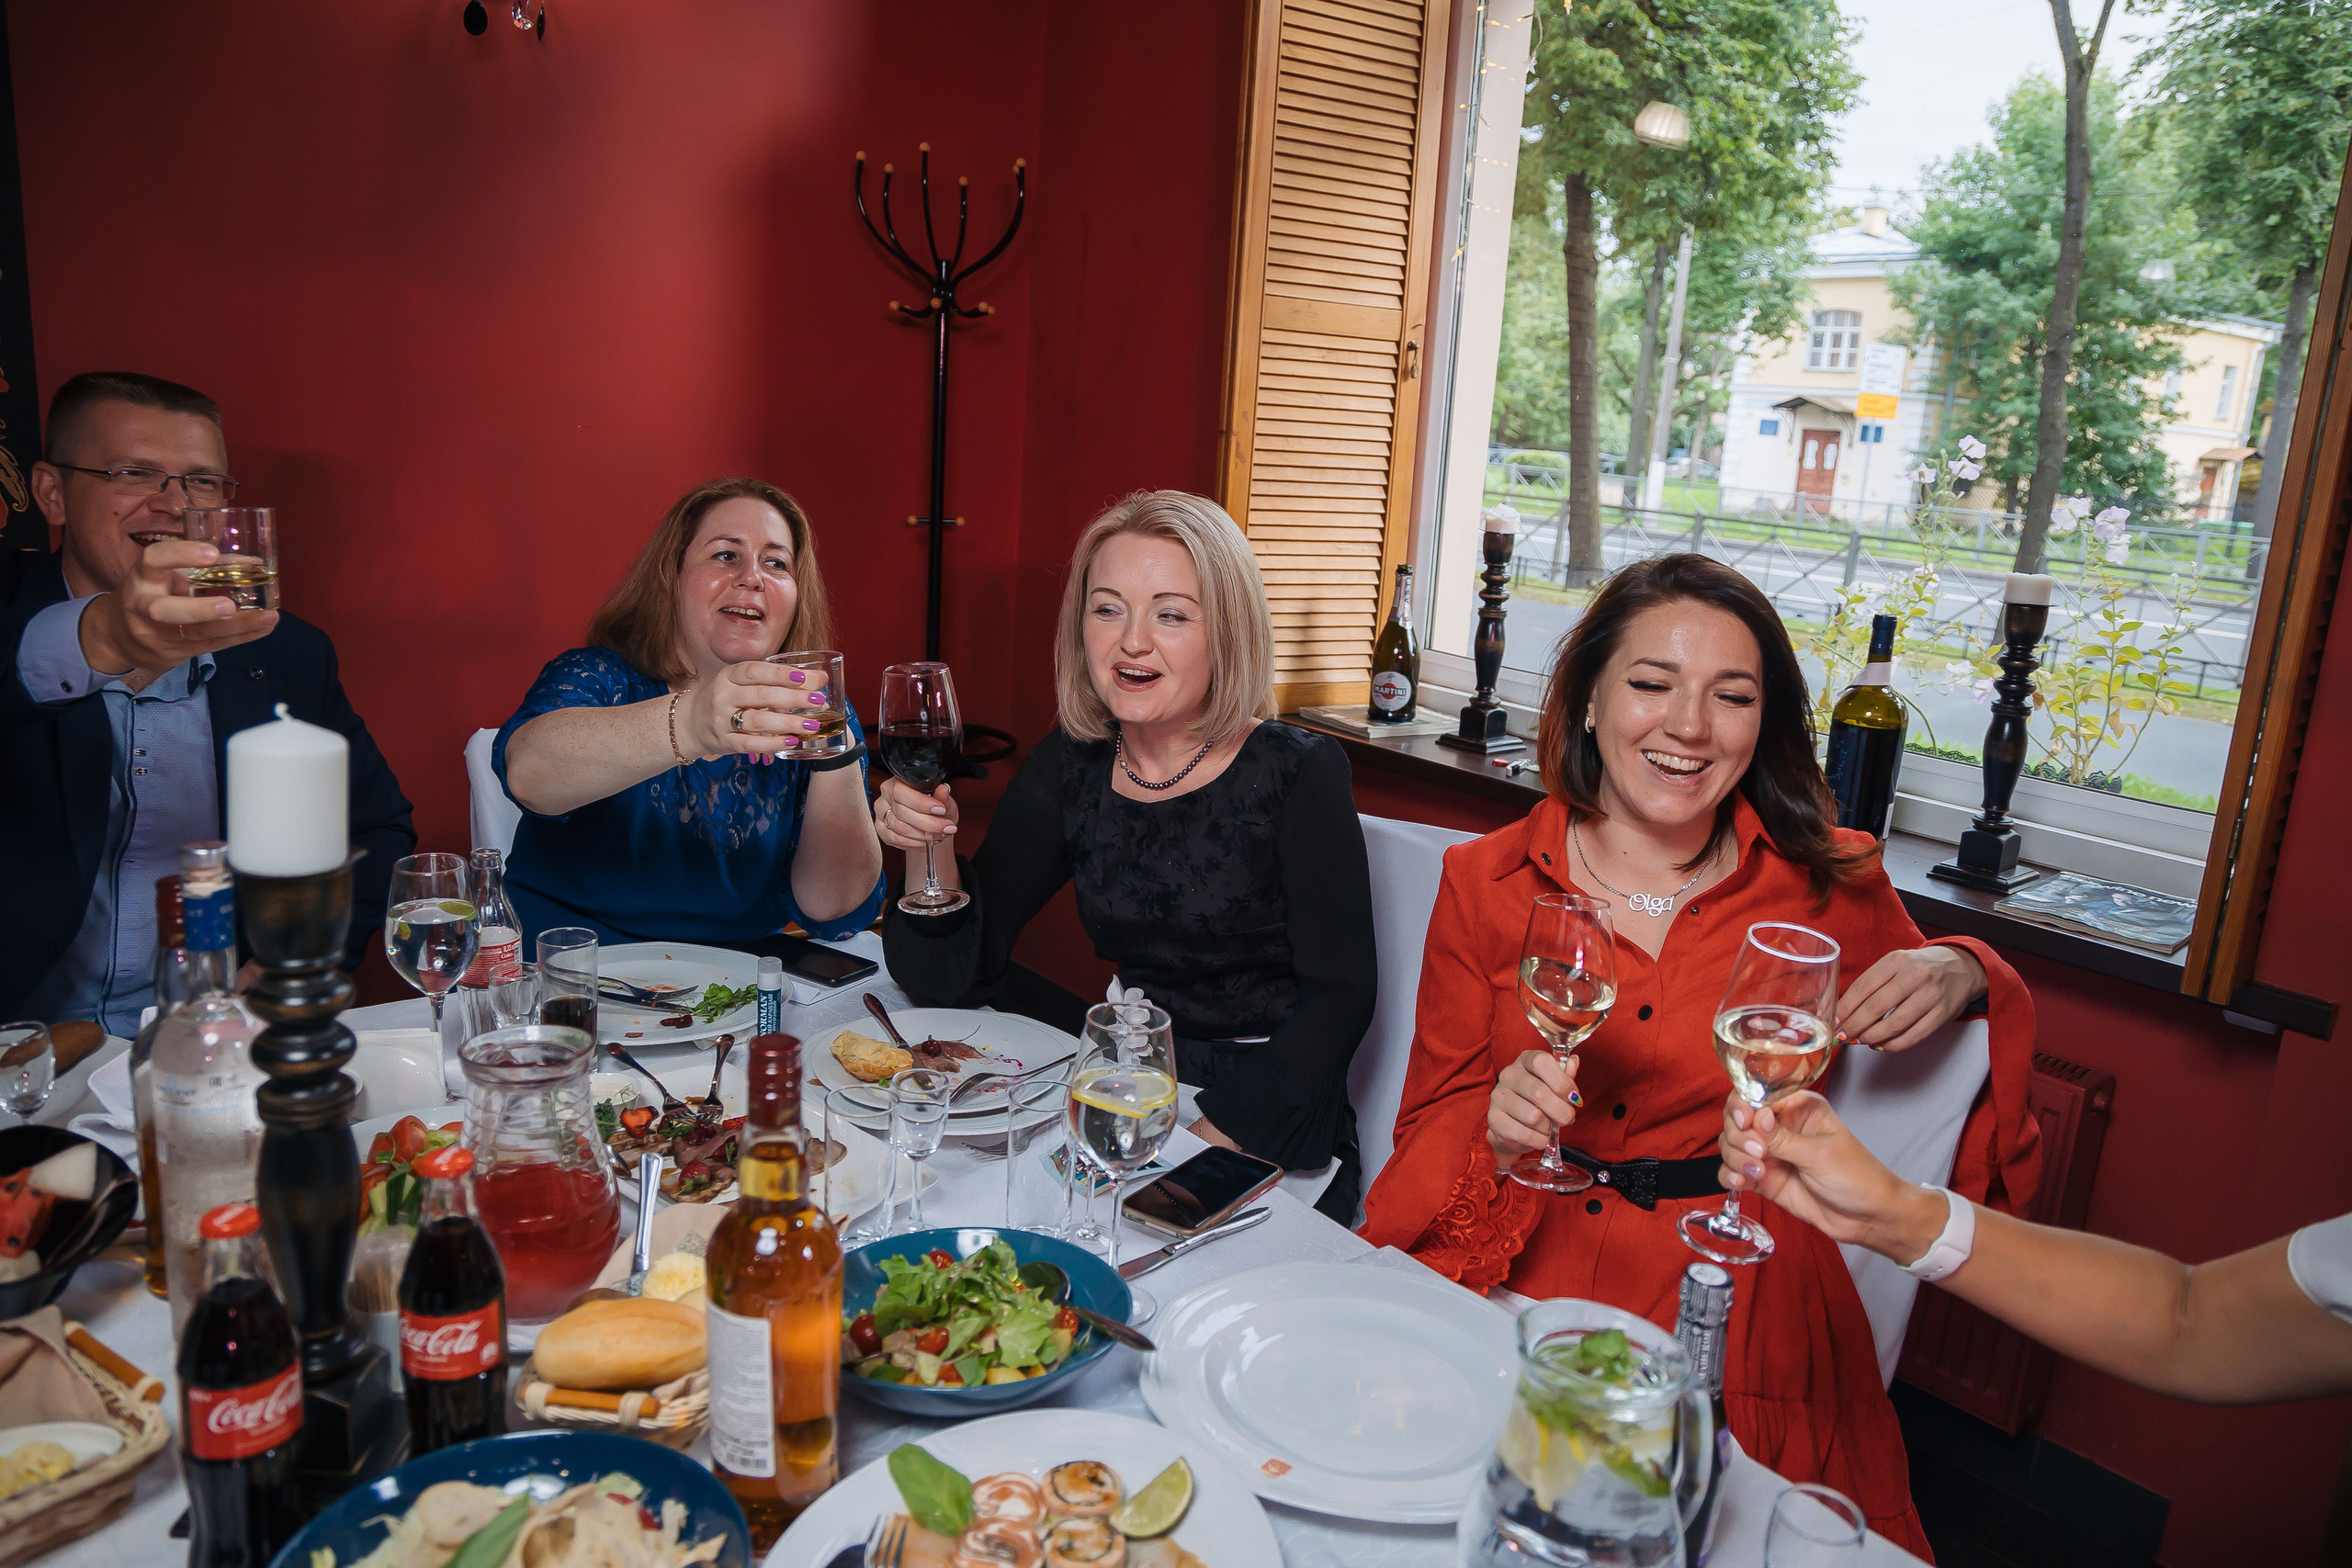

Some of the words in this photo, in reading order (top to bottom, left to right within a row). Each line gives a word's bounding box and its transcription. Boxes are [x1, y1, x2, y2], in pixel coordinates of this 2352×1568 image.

[1374, 685, 1407, 696] MARTINI
[1629, 893, 1675, 918] Olga
[760, 994, 768, 1037] NORMAN
